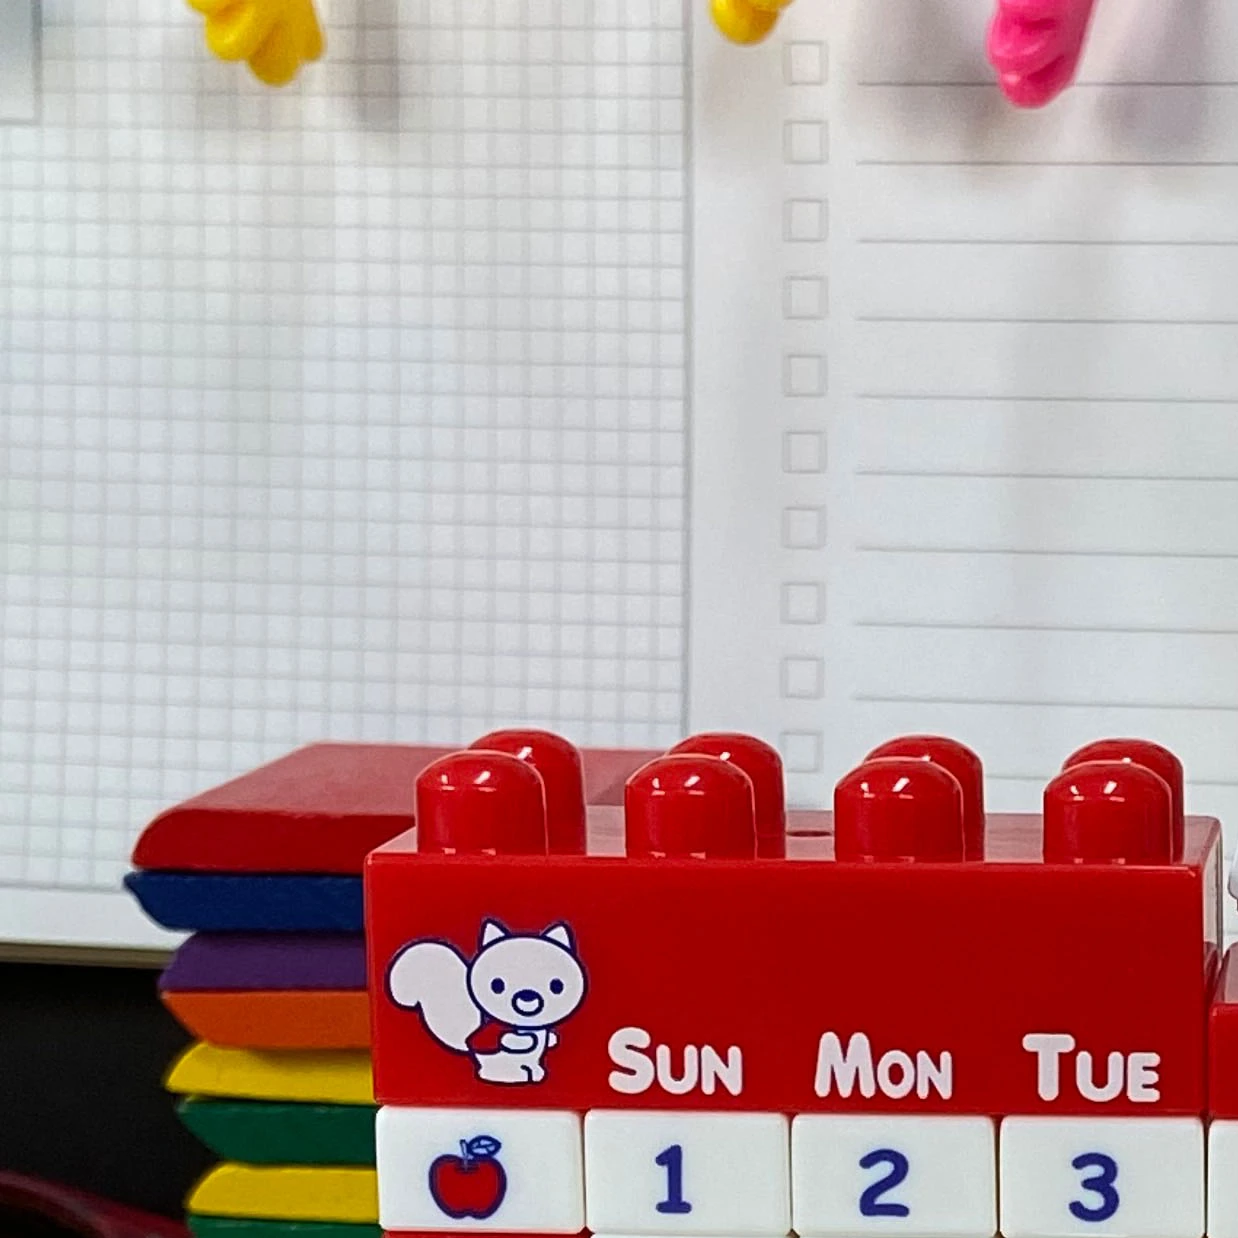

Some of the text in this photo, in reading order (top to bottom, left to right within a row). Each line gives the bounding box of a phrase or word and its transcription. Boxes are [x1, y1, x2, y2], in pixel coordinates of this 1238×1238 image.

[607, 1027, 1161, 1102] SUN MON TUE
[654, 1143, 693, 1216] 1
[858, 1146, 910, 1219] 2
[1068, 1150, 1121, 1224] 3
